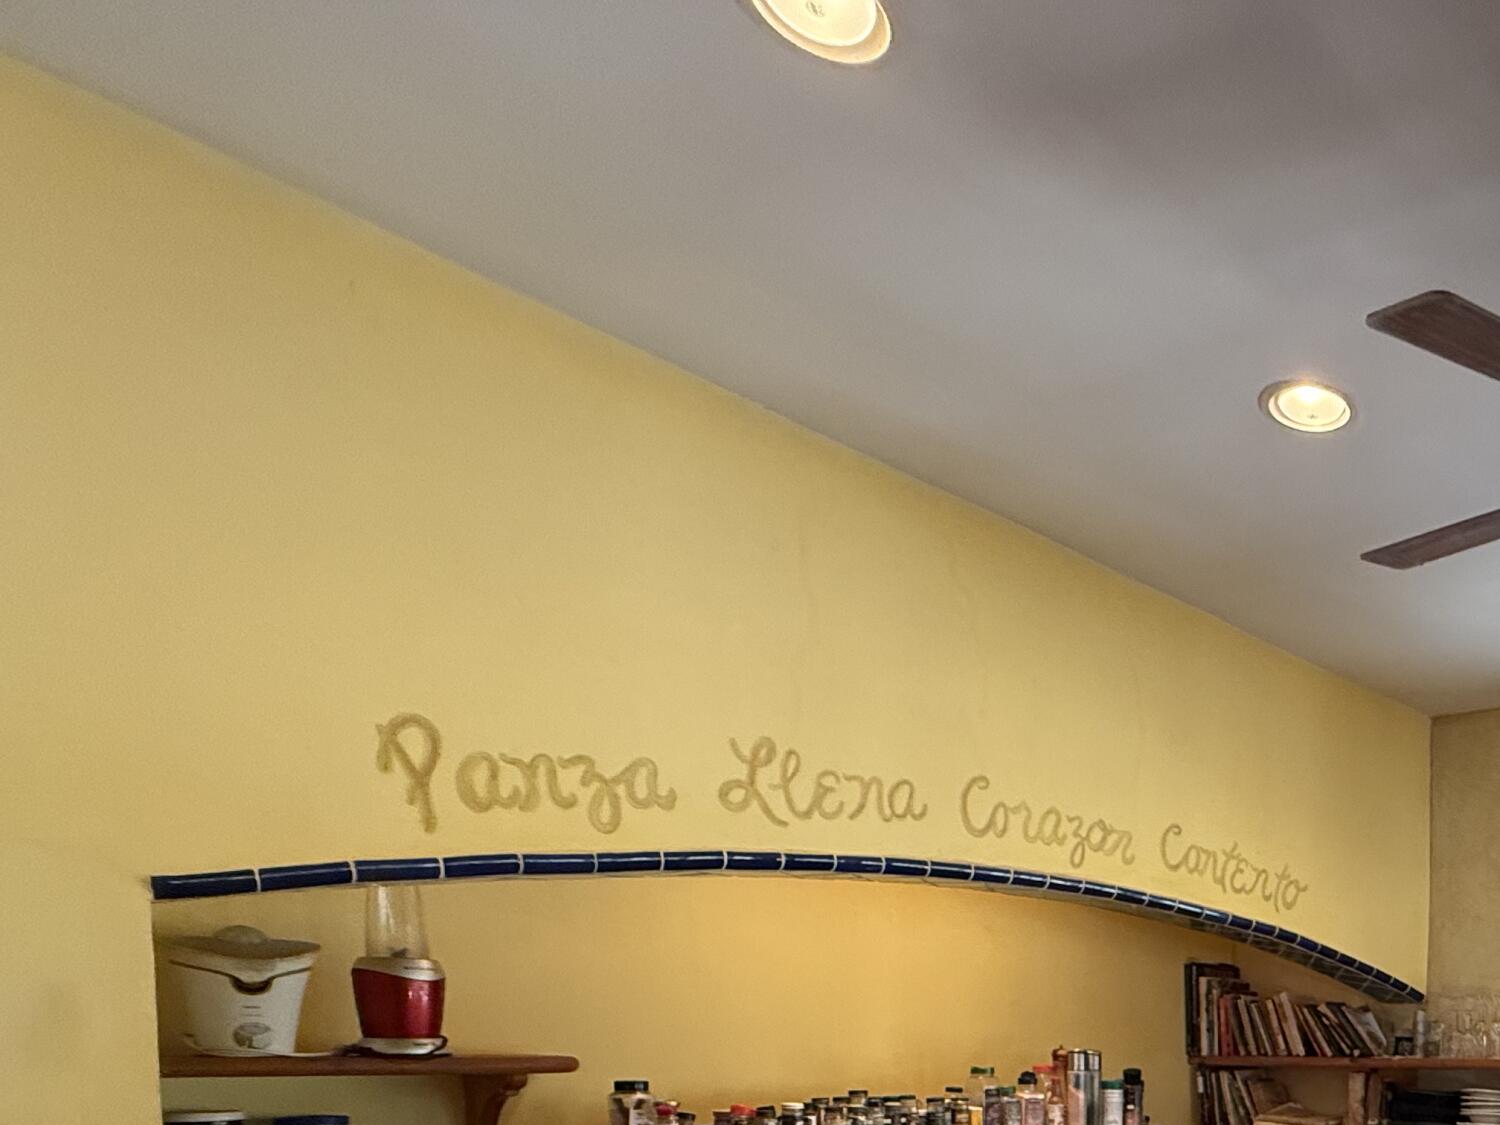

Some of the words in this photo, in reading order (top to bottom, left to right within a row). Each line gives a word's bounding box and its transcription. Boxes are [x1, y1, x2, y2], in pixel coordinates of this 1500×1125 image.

[374, 712, 678, 834] Panza
[718, 736, 928, 828] Llena
[960, 775, 1136, 869] Corazon
[1160, 823, 1308, 913] Contento
